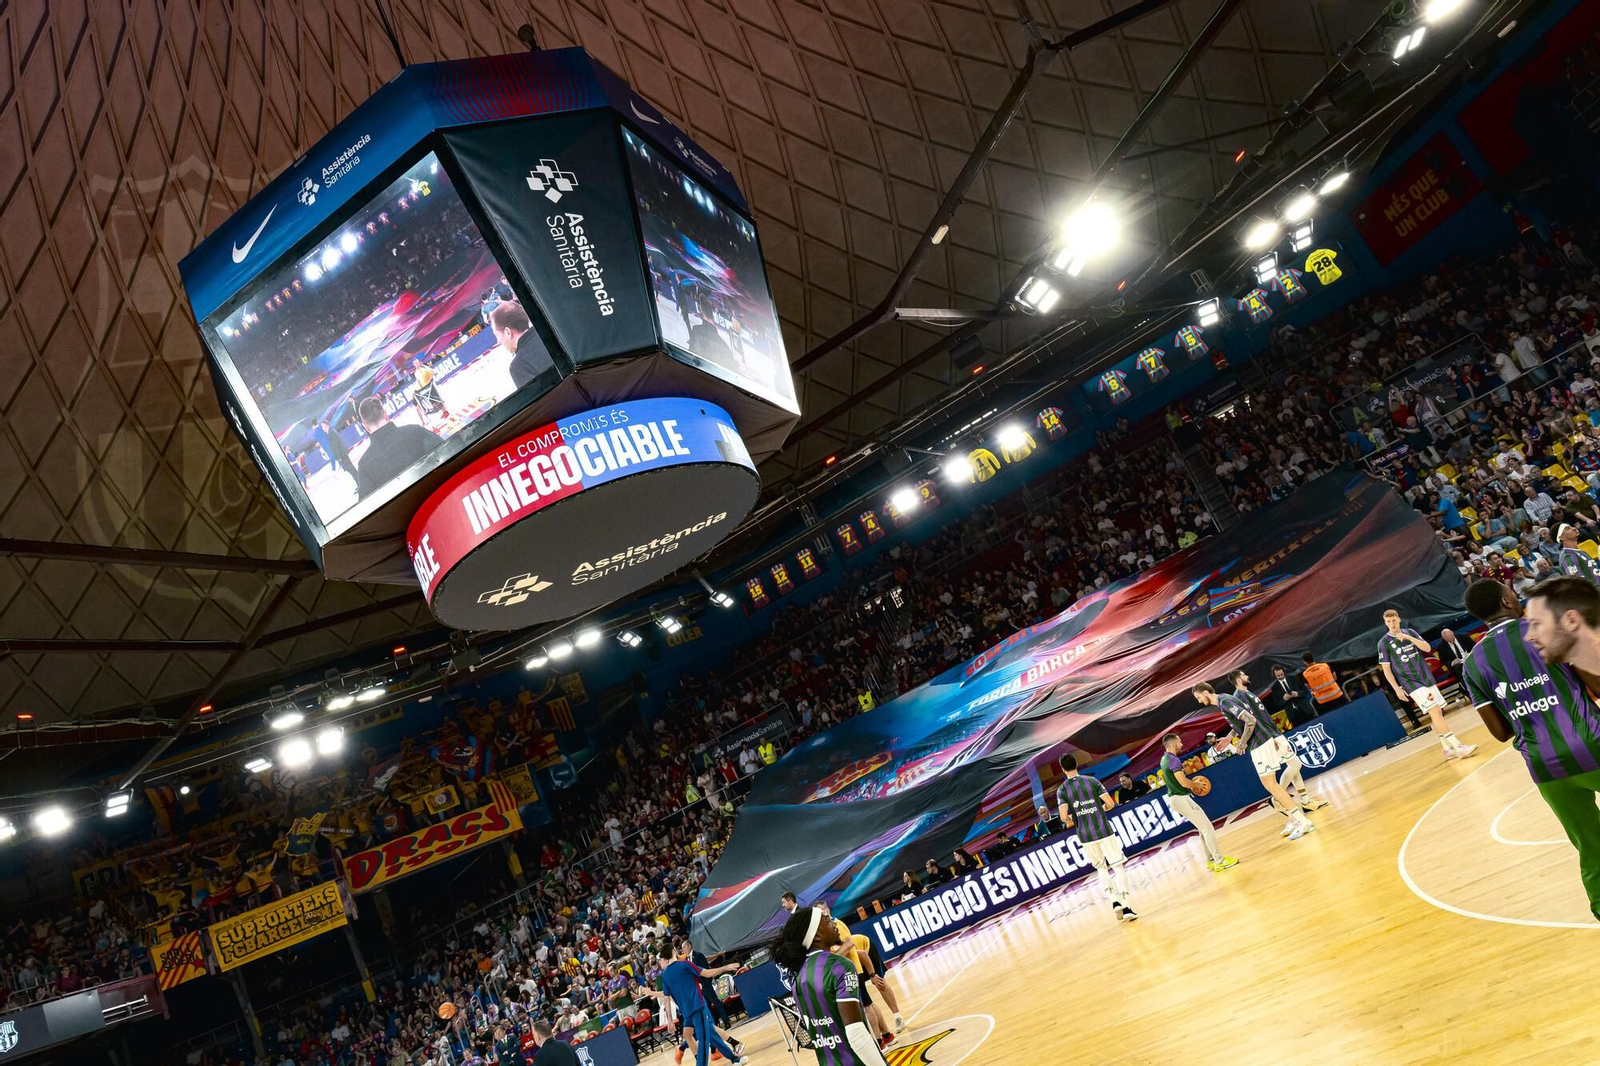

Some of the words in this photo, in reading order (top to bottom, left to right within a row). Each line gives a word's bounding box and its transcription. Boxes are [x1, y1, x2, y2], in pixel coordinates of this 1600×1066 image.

[322, 134, 371, 179] Assistència
[324, 155, 361, 188] Sanitària
[1383, 192, 1412, 222] MÉS
[1408, 168, 1439, 201] QUE
[1394, 214, 1418, 237] UN
[1415, 188, 1450, 221] CLUB
[546, 215, 585, 288] Sanitària
[564, 212, 615, 316] Assistència
[1313, 256, 1332, 272] 28
[1109, 379, 1119, 390] 8
[1146, 356, 1156, 368] 7
[498, 452, 516, 468] EL
[517, 415, 609, 457] COMPROMÍS
[610, 409, 629, 425] ÉS
[1042, 415, 1059, 429] 14
[461, 419, 691, 536] INNEGOCIABLE
[571, 511, 728, 575] Assistència
[571, 541, 680, 586] Sanitària
[1027, 644, 1087, 684] BARÇA
[1509, 673, 1550, 693] Unicaja
[346, 803, 511, 889] DRACS
[216, 886, 339, 949] SUPPORTERS
[872, 874, 988, 953] L'AMBICIÓ
[986, 862, 1018, 903] ÉS
